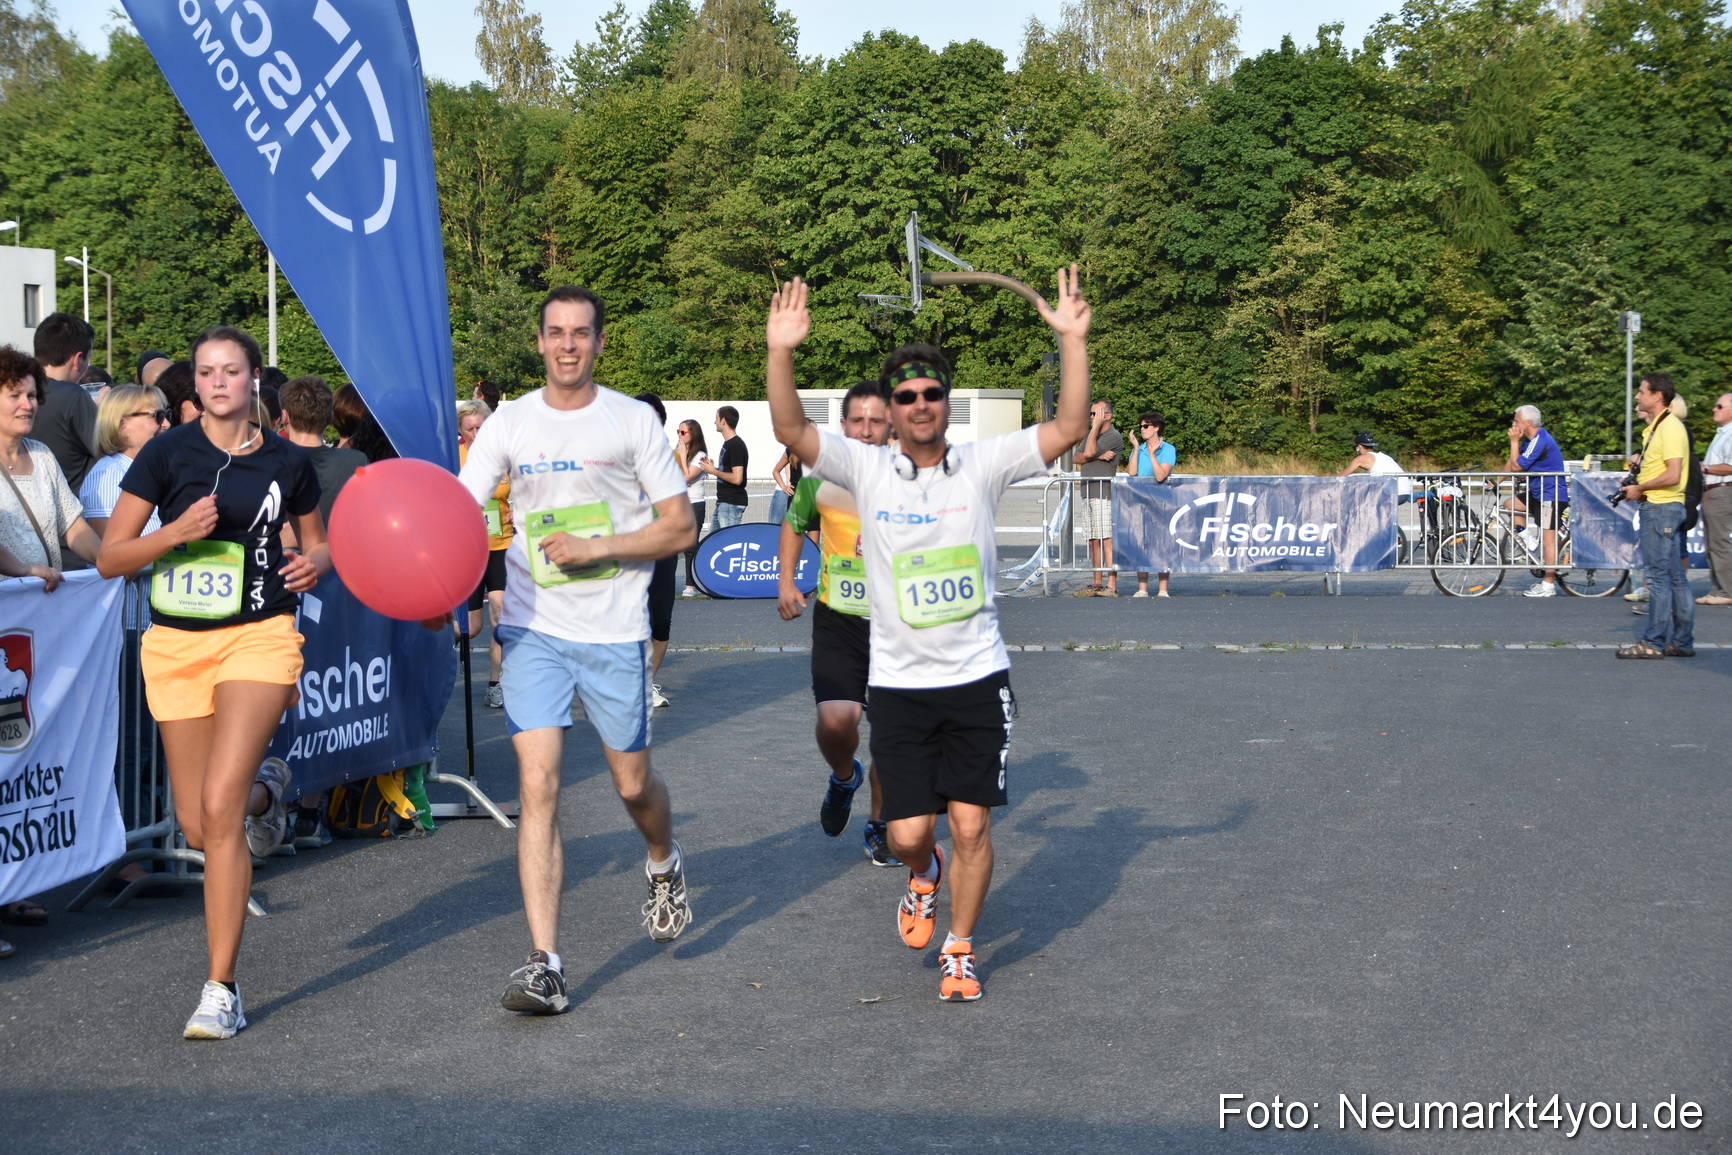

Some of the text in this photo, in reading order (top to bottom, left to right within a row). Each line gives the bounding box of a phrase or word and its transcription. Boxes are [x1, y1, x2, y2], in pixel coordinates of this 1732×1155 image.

[1200, 516, 1338, 542] Fischer
[729, 556, 808, 572] Fischr
[1212, 546, 1326, 558] AUTOMOBILE
[163, 568, 233, 597] 1133
[906, 576, 974, 606] 1306
[285, 712, 389, 762] AUTOMOBILE
